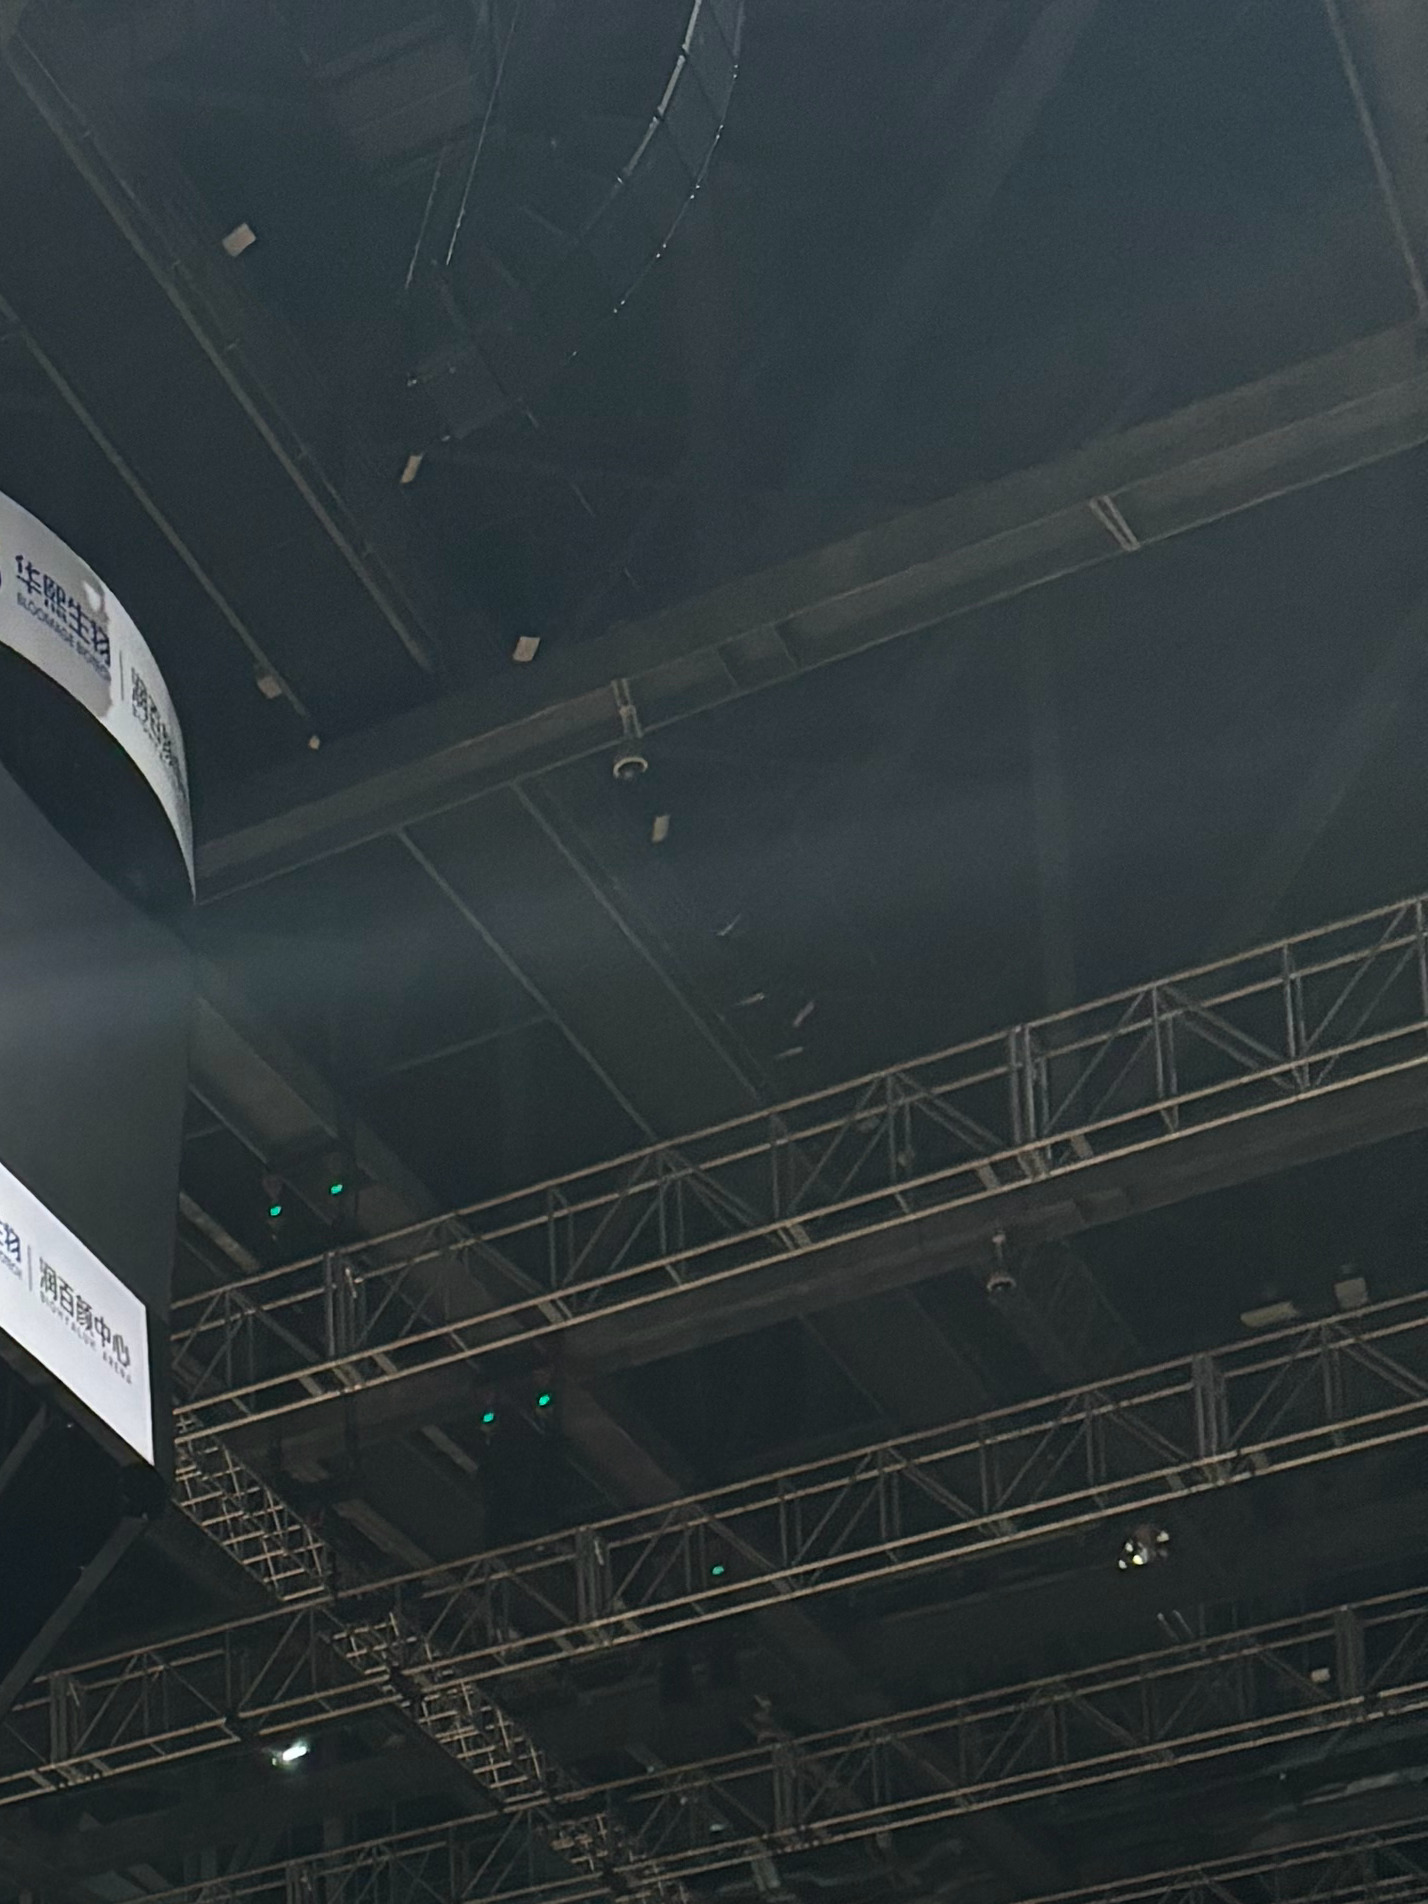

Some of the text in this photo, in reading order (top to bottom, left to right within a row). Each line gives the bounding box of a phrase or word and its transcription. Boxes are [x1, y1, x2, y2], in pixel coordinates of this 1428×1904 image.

[38, 1255, 131, 1369] 润百颜中心
